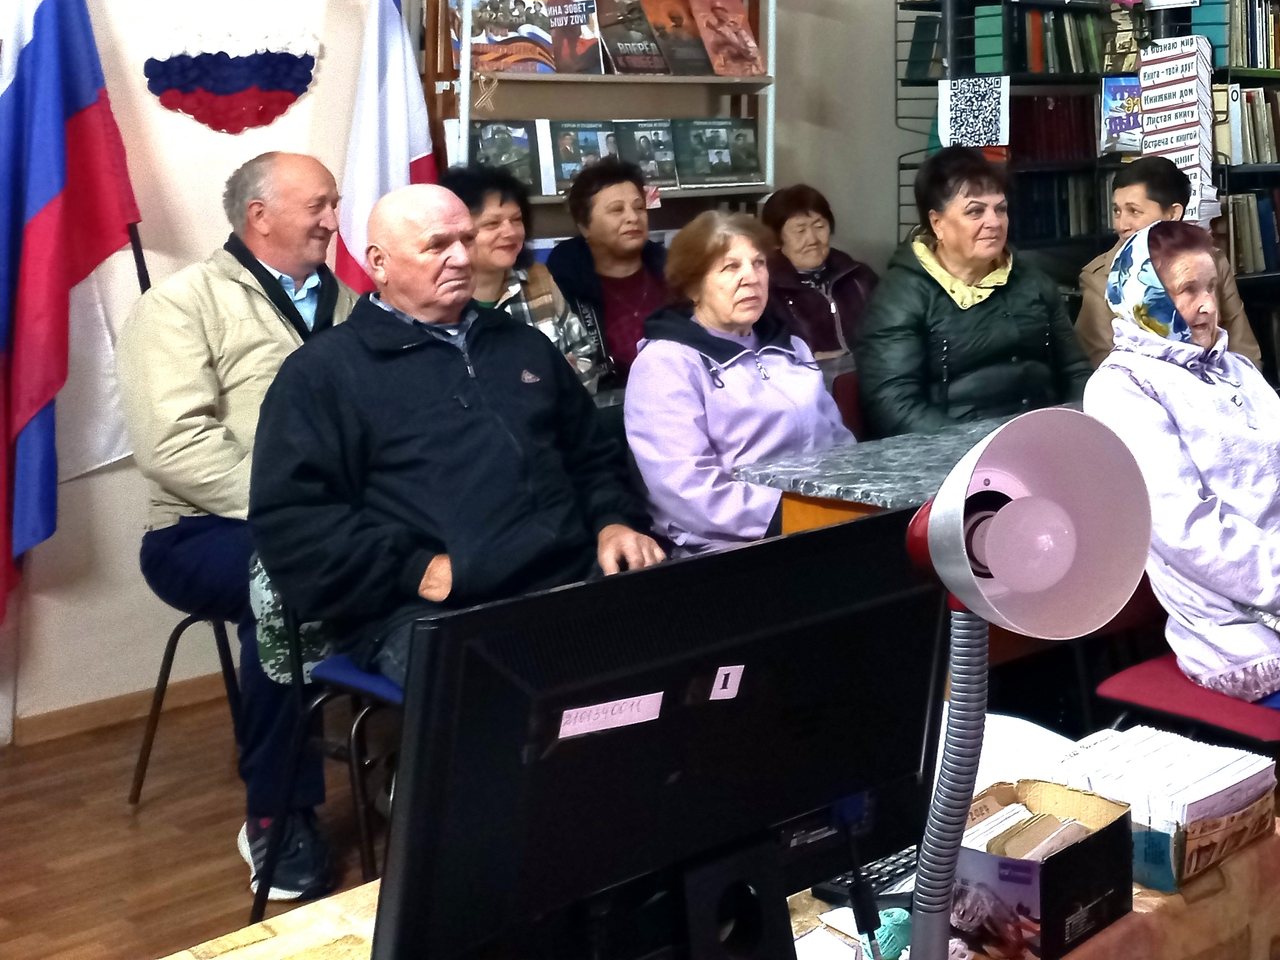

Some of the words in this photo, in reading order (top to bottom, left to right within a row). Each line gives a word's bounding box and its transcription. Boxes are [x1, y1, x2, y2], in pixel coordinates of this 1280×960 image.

[1180, 38, 1194, 48] мир
[1180, 61, 1194, 74] друг
[1144, 136, 1169, 150] Встреча
